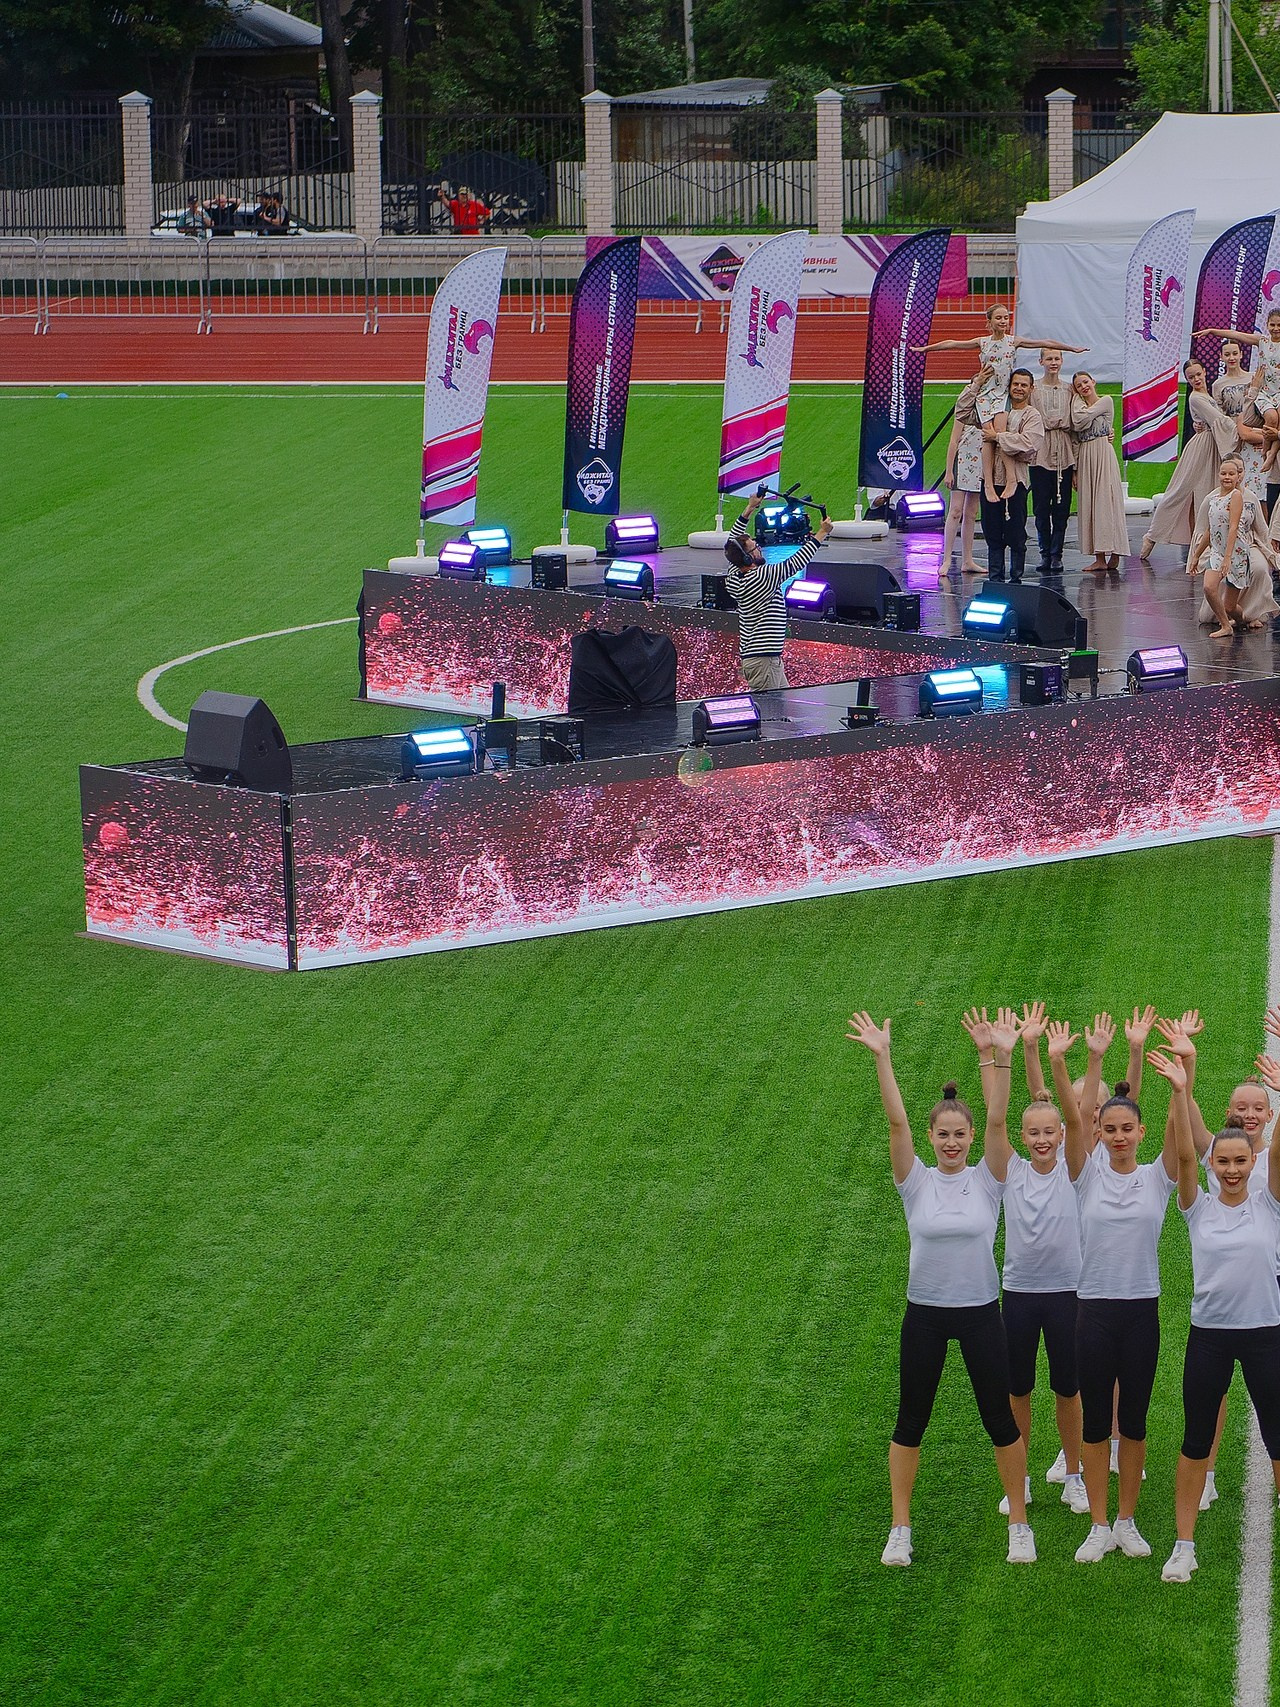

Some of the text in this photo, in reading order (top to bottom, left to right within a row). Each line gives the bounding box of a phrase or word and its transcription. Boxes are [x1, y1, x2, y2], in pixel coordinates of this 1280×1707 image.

[904, 279, 917, 311] СТРАН
[911, 258, 921, 278] СНГ
[1153, 268, 1163, 322] БЕЗ ГРАНИЦ
[1230, 245, 1248, 325] ИГРЫ СТРАН СНГ
[455, 310, 469, 370] БЕЗ ГРАНИЦ
[759, 291, 771, 347] БЕЗ ГРАНИЦ
[900, 312, 910, 340] ИГРЫ
[597, 271, 619, 450] МЕЖДУНАРОДНЫЕ ИГРЫ СТРАН СНГ
[589, 364, 603, 444] ИНКЛЮЗИВНЫЕ
